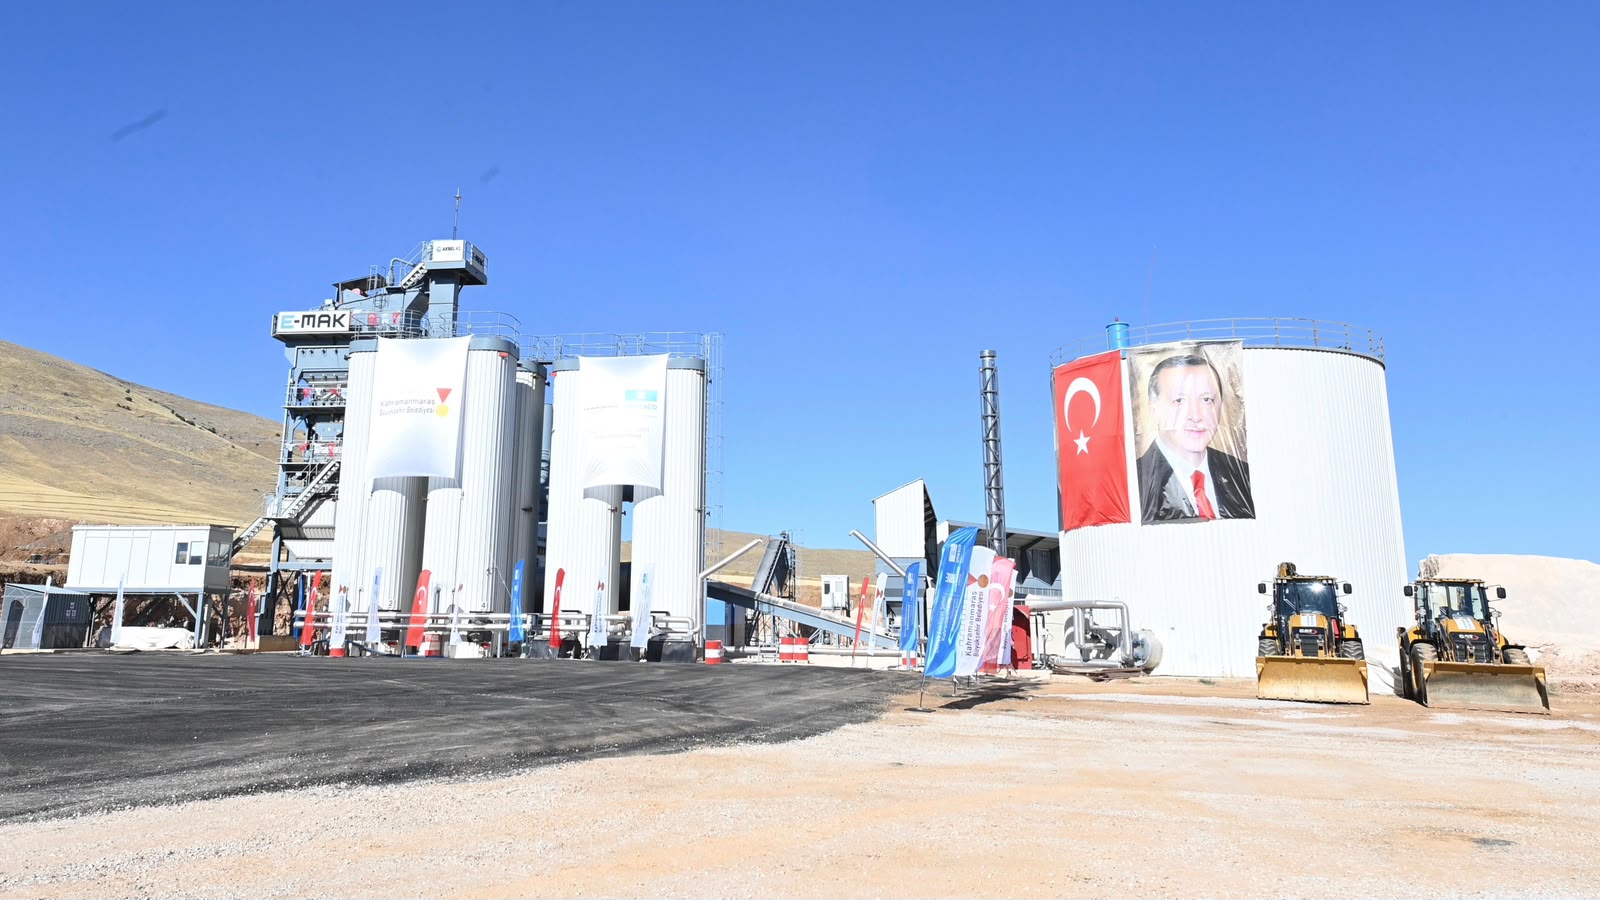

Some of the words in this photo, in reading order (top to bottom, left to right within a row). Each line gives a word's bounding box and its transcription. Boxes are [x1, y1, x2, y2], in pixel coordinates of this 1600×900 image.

[280, 314, 346, 328] E-MAK
[975, 591, 984, 621] Belediyesi
[964, 591, 977, 656] Kahramanmaraş
[972, 624, 981, 657] Büyükşehir
